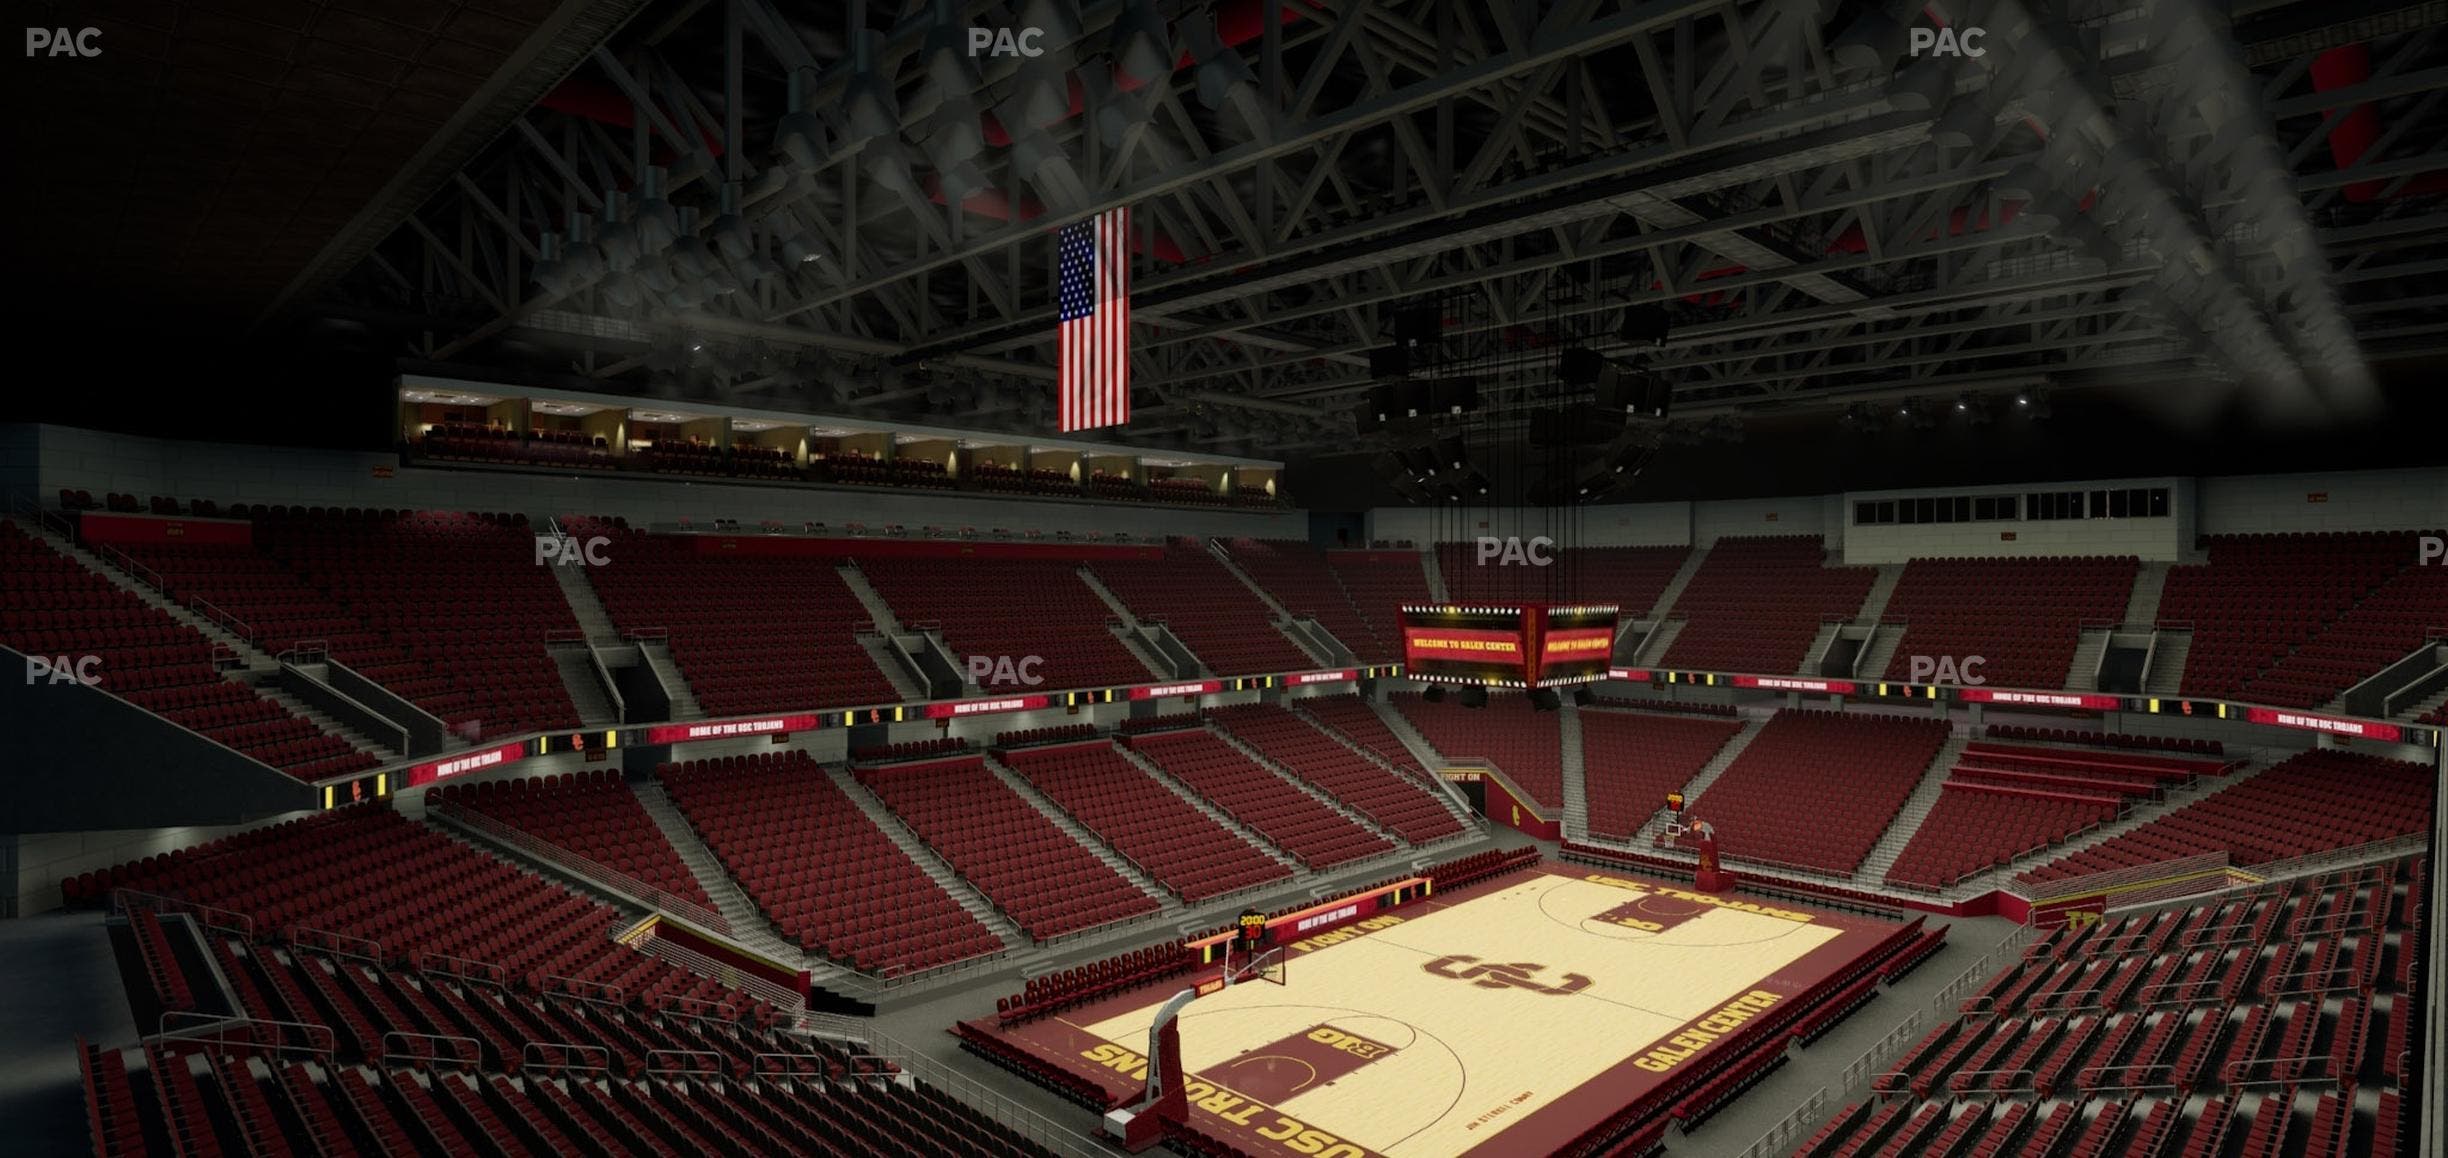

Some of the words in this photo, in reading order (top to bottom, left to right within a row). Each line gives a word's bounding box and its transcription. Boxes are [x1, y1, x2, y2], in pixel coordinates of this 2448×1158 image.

[1413, 638, 1448, 649] WELCOME
[1448, 640, 1460, 649] TO
[1485, 641, 1516, 652] CENTER
[689, 726, 712, 737] HOME
[712, 725, 723, 735] OF
[723, 723, 737, 735] THE
[737, 722, 752, 733] USC
[752, 719, 784, 732] TROJANS
[1467, 773, 1480, 782] ON
[1239, 914, 1265, 926] 20:00
[1632, 1028, 1720, 1073] GALEN
[1696, 990, 1784, 1034] CENTER
